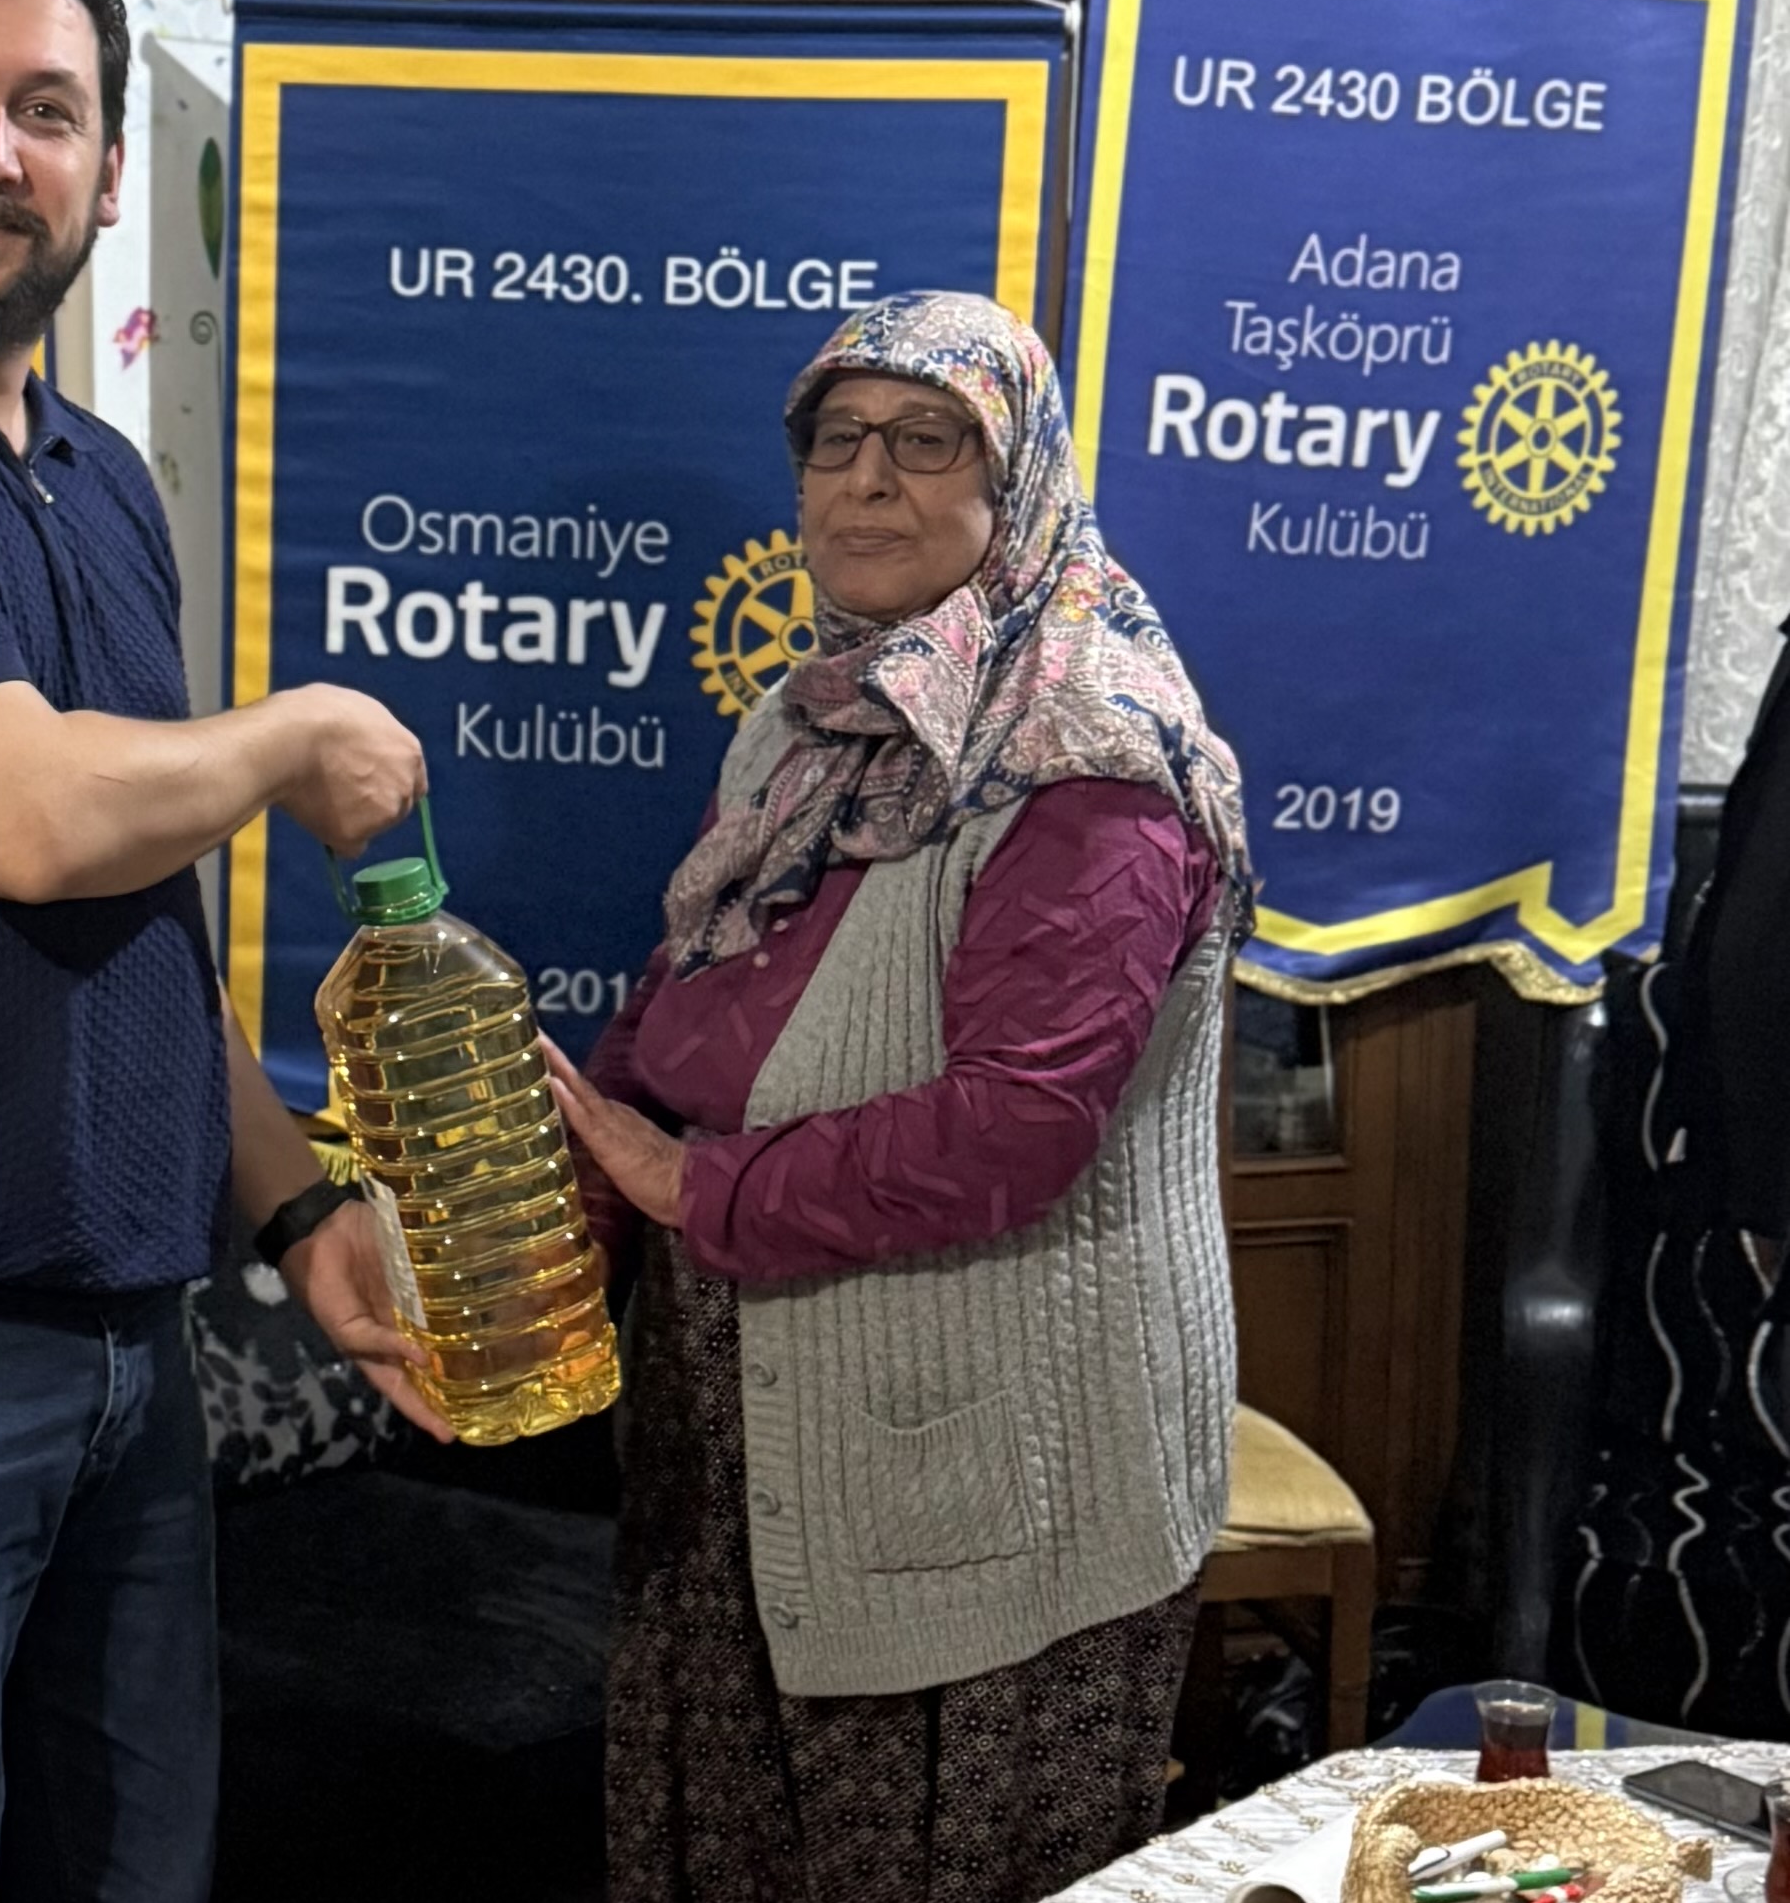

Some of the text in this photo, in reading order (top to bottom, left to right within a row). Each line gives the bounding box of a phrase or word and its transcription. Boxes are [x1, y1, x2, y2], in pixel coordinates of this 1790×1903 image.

[1173, 55, 1607, 131] UR 2430 BÖLGE
[390, 246, 878, 310] UR 2430. BÖLGE
[1288, 232, 1461, 292] Adana
[1224, 300, 1452, 375] Taşköprü
[1516, 363, 1583, 386] ROTARY
[1148, 375, 1441, 488] Rotary
[361, 494, 669, 575] Osmaniye
[1247, 501, 1429, 560] Kulübü
[760, 550, 808, 576] ROT
[324, 566, 666, 686] Rotary
[457, 702, 665, 768] Kulübü
[1272, 784, 1401, 833] 2019
[536, 967, 627, 1015] 201
